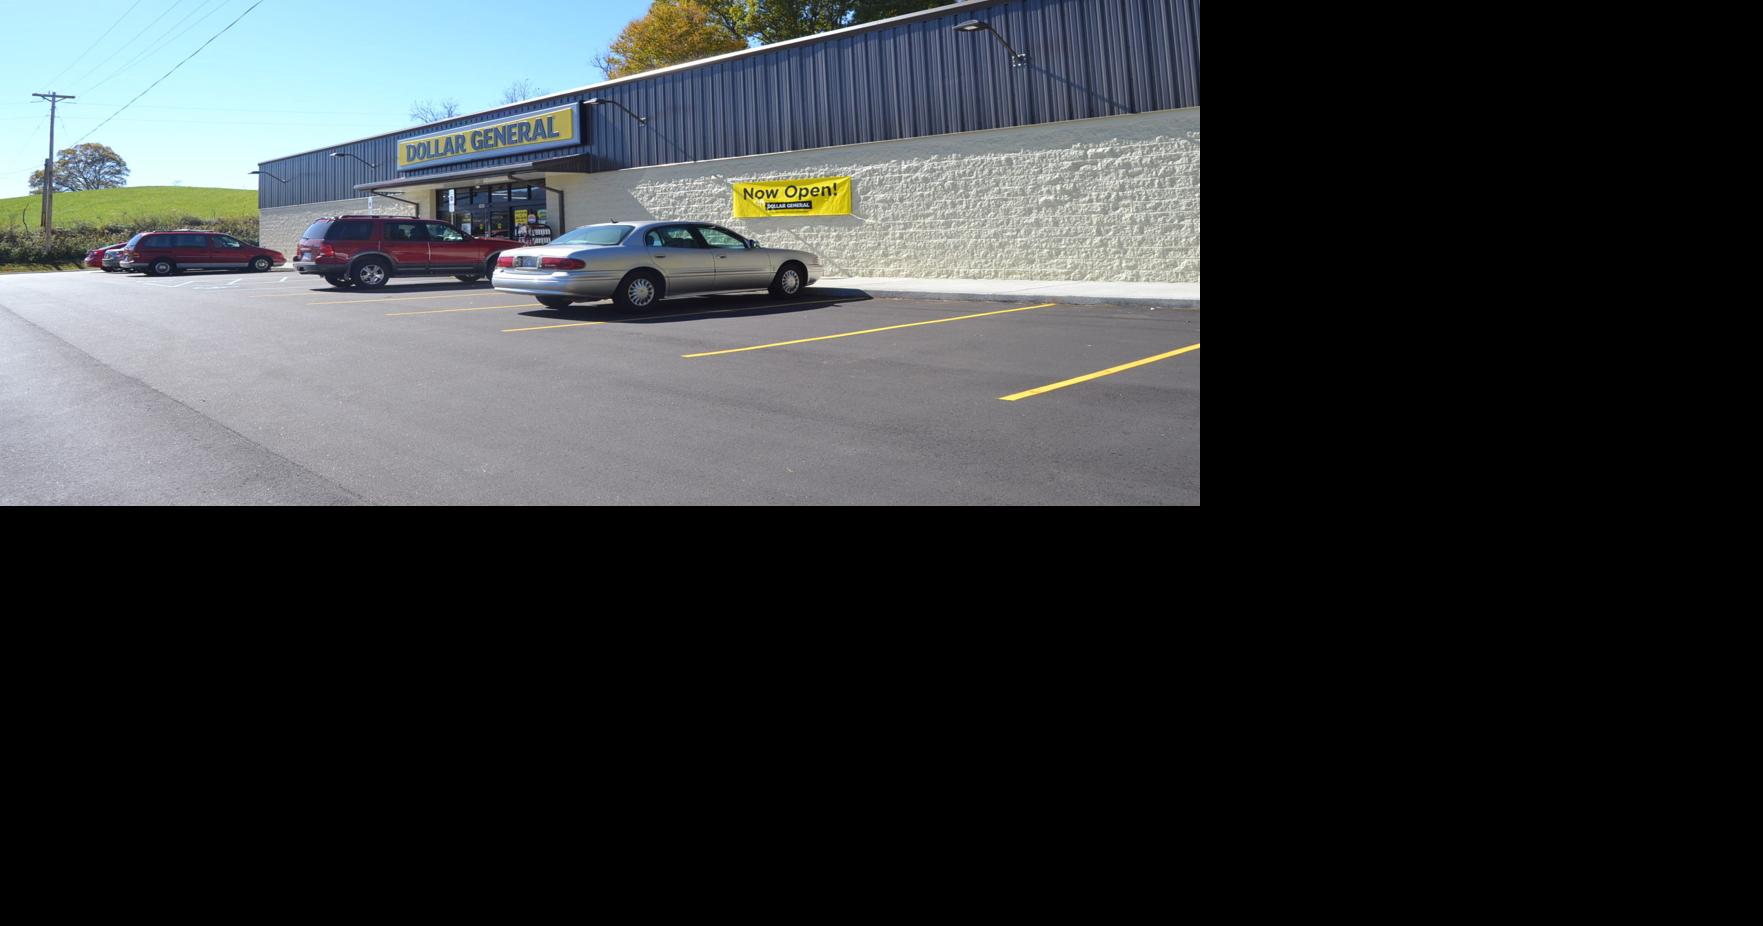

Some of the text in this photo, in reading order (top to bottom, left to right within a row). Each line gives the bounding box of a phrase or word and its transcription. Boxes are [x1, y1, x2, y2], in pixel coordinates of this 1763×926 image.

[406, 116, 559, 162] DOLLAR GENERAL
[743, 183, 838, 201] Now Open!
